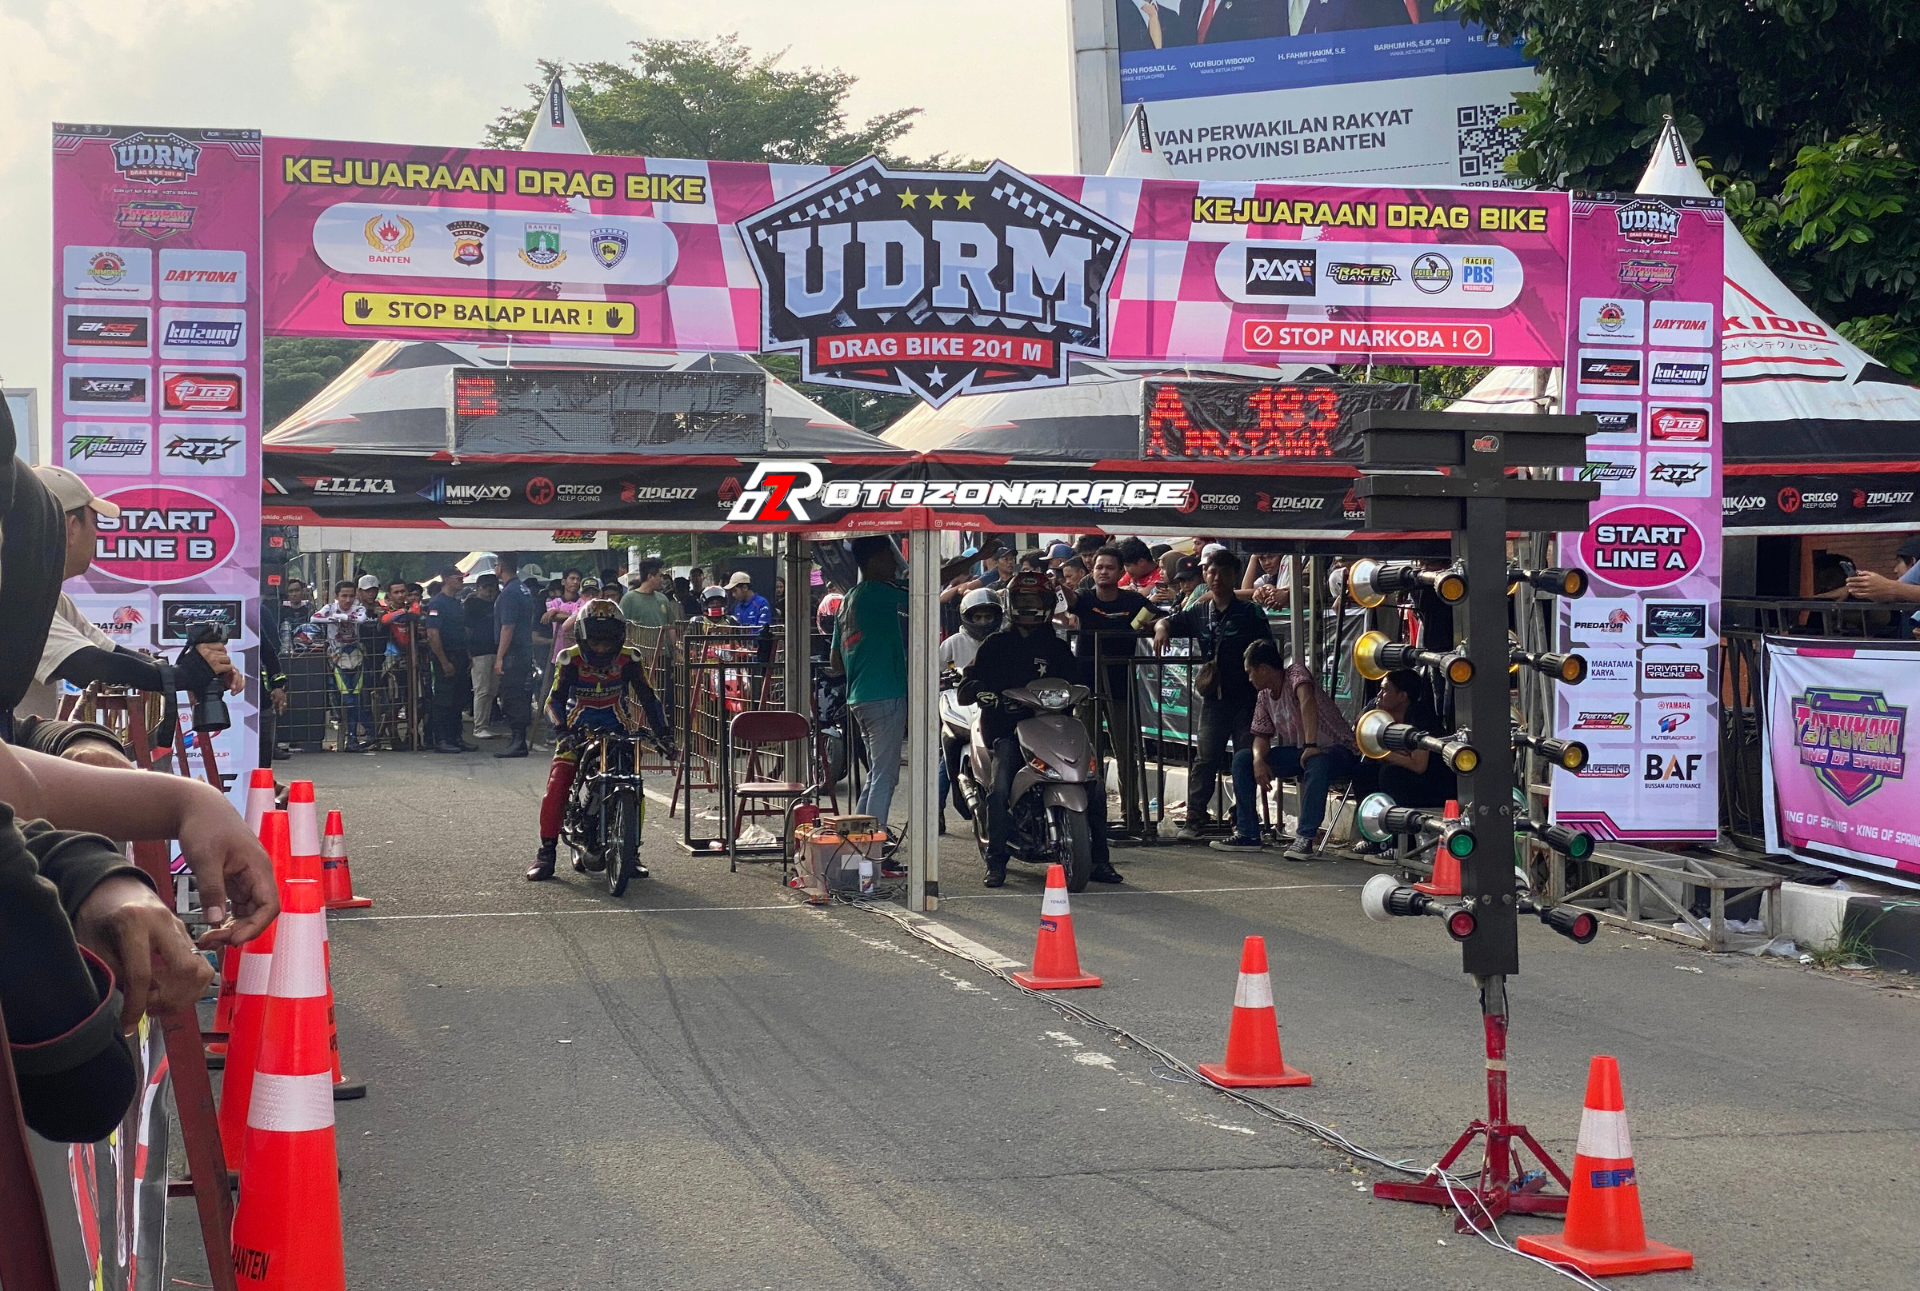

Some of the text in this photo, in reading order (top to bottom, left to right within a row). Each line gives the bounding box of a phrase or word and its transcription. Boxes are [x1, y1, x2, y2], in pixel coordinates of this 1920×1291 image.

[1286, 51, 1308, 59] FAHMI
[1374, 41, 1405, 51] BARHUM
[1189, 56, 1255, 69] YUDI BUDI WIBOWO
[1199, 117, 1330, 142] PERWAKILAN
[1332, 108, 1413, 130] RAKYAT
[1207, 140, 1300, 162] PROVINSI
[1303, 132, 1386, 153] BANTEN
[118, 145, 196, 169] UDRM
[284, 157, 705, 202] KEJUARAAN DRAG BIKE
[1194, 197, 1547, 232] KEJUARAAN DRAG BIKE
[1621, 210, 1677, 233] UDRM
[368, 254, 411, 264] BANTEN
[1465, 257, 1493, 265] RACING
[164, 269, 238, 283] DAYTONA
[776, 219, 1093, 329] UDRM
[1338, 267, 1393, 279] RACER
[1340, 274, 1390, 282] BANTEN
[1463, 265, 1493, 284] PBS
[388, 301, 593, 326] STOP BALAP LIAR !
[1653, 318, 1707, 330] DAYTONA
[1722, 315, 1827, 337] KIDO
[1279, 328, 1458, 349] STOP NARKOBA !
[829, 337, 1042, 361] DRAG BIKE 201 M
[1149, 387, 1189, 428] A
[172, 442, 230, 456] RTX
[1656, 467, 1697, 480] RTX
[314, 477, 396, 493] ELLKA
[446, 484, 511, 502] MIKAYO
[557, 484, 602, 494] CRIZGO
[1200, 493, 1241, 504] CRIZGO
[1801, 492, 1839, 502] CRIZGO
[96, 510, 213, 530] START
[1597, 526, 1686, 544] START
[96, 539, 213, 559] LINE B
[1596, 550, 1686, 569] LINE A
[1574, 621, 1623, 629] PREDATOR
[1591, 660, 1633, 668] MAHATAMA
[1591, 668, 1615, 676] KARYA
[1646, 664, 1698, 672] PRIVATER
[1665, 701, 1691, 710] YAMAHA
[1796, 705, 1901, 755] TATSUMAKI
[1644, 753, 1703, 781] BAF
[1831, 750, 1850, 766] OF
[1852, 753, 1902, 773] SPRING
[1806, 813, 1818, 825] OF
[1856, 824, 1879, 838] KING
[1881, 829, 1894, 841] OF
